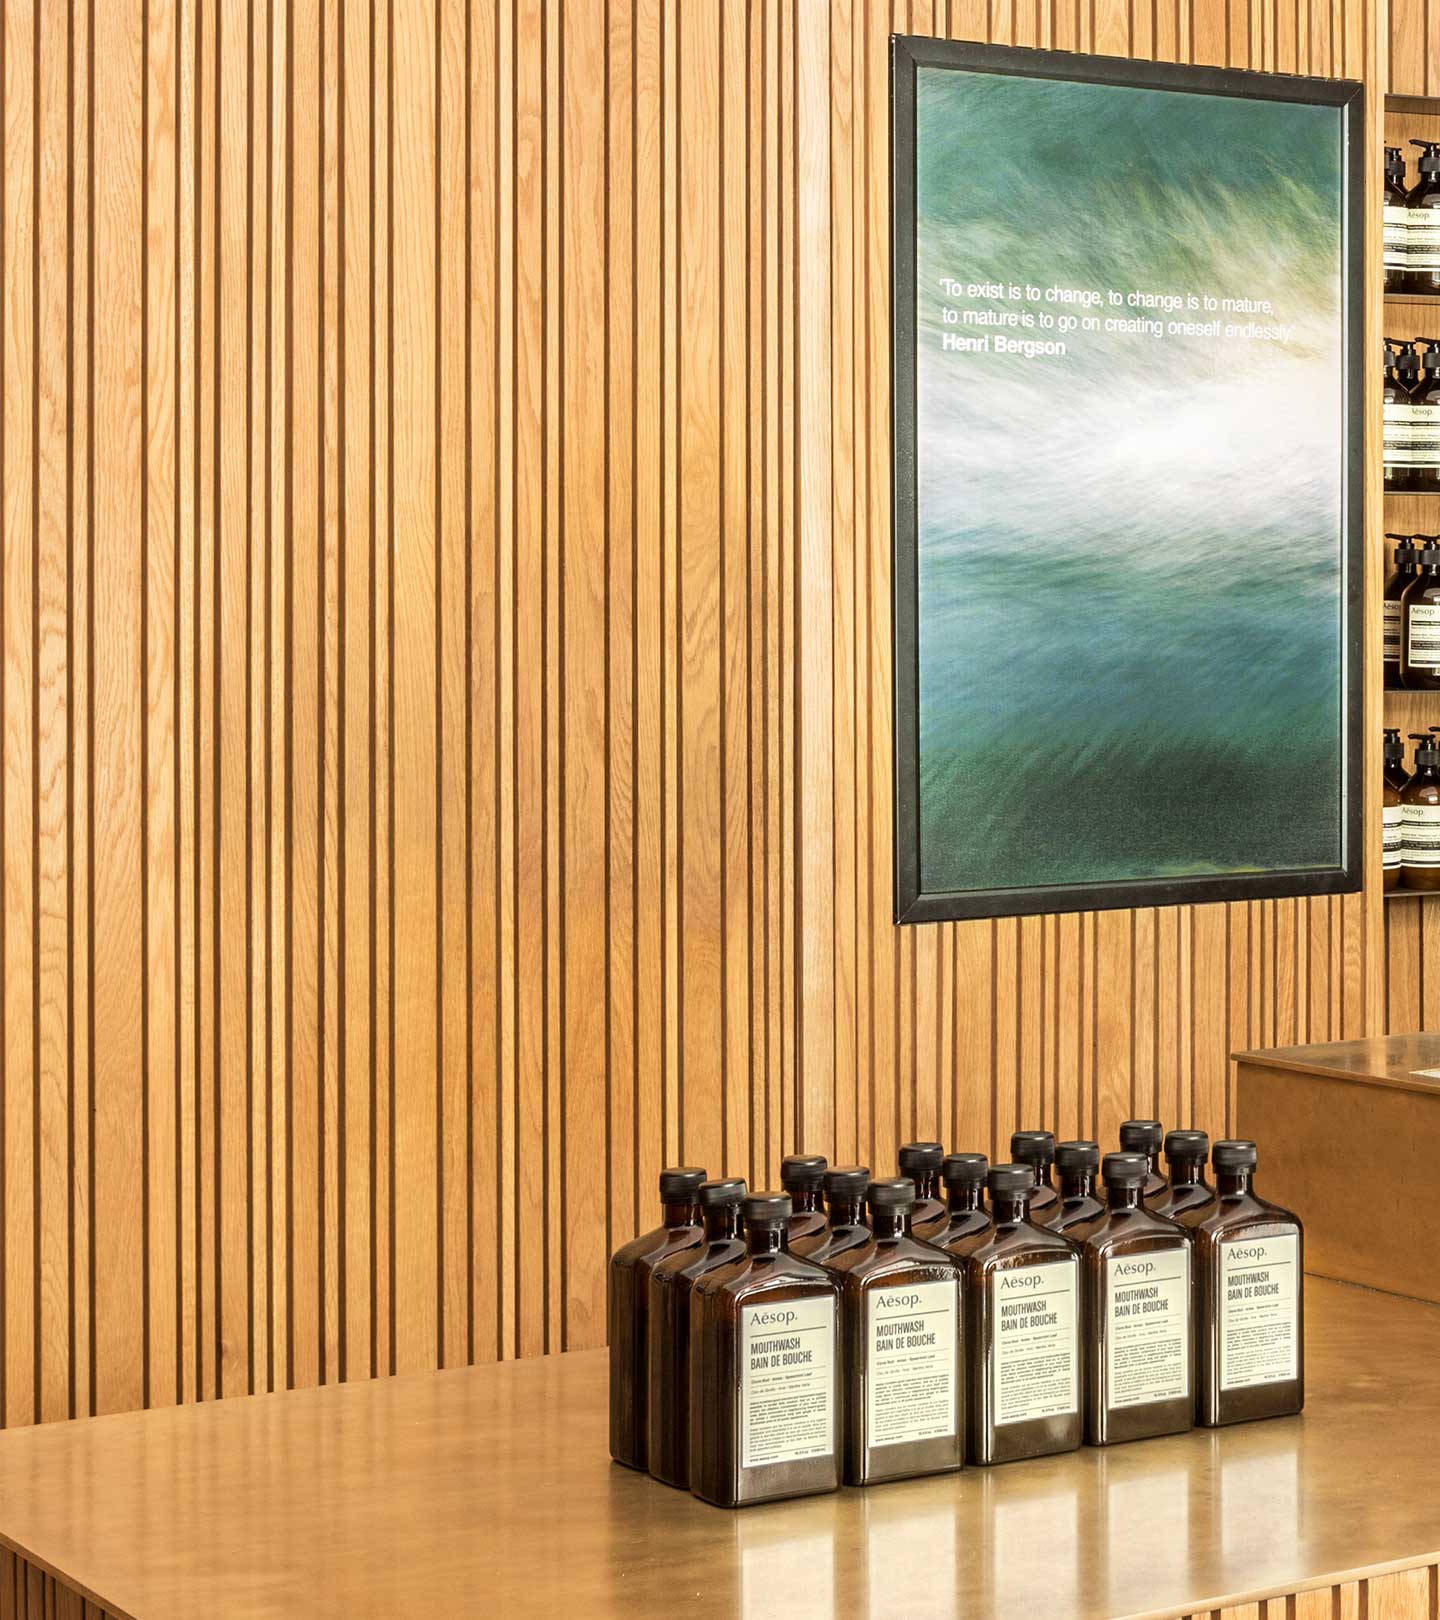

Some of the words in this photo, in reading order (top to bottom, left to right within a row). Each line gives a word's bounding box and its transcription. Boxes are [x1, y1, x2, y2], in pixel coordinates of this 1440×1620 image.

[967, 281, 1004, 299] exist
[1008, 282, 1022, 300] is
[1025, 284, 1041, 301] to
[1045, 285, 1104, 308] change,
[1108, 289, 1123, 306] to
[1127, 290, 1183, 313] change
[1187, 292, 1200, 310] is
[1203, 294, 1218, 311] to
[1222, 297, 1274, 316] mature,
[942, 307, 958, 324] to
[963, 309, 1018, 327] mature
[1021, 310, 1034, 328] is
[1038, 311, 1054, 328] to
[1058, 314, 1077, 333] go
[1081, 316, 1101, 331] on
[1104, 316, 1163, 338] creating
[1168, 320, 1221, 336] oneself
[942, 333, 989, 352] Henri
[994, 335, 1066, 358] Bergson
[1227, 1271, 1269, 1287] MOUTHWASH
[1114, 1286, 1158, 1303] MOUTHWASH
[1227, 1288, 1242, 1301] BAIN
[1244, 1286, 1252, 1298] DE
[1253, 1283, 1279, 1297] BOUCHE
[1001, 1300, 1047, 1317] MOUTHWASH
[1114, 1305, 1130, 1317] BAIN
[1132, 1302, 1141, 1314] DE
[1142, 1298, 1168, 1313] BOUCHE
[876, 1320, 924, 1337] MOUTHWASH
[1001, 1319, 1017, 1332] BAIN
[1019, 1316, 1028, 1329] DE
[1030, 1312, 1057, 1327] BOUCHE
[751, 1337, 800, 1355] MOUTHWASH
[876, 1339, 893, 1352] BAIN
[896, 1337, 905, 1349] DE
[906, 1333, 936, 1348] BOUCHE
[751, 1356, 768, 1370] BAIN
[771, 1354, 780, 1367] DE
[782, 1350, 812, 1365] BOUCHE
